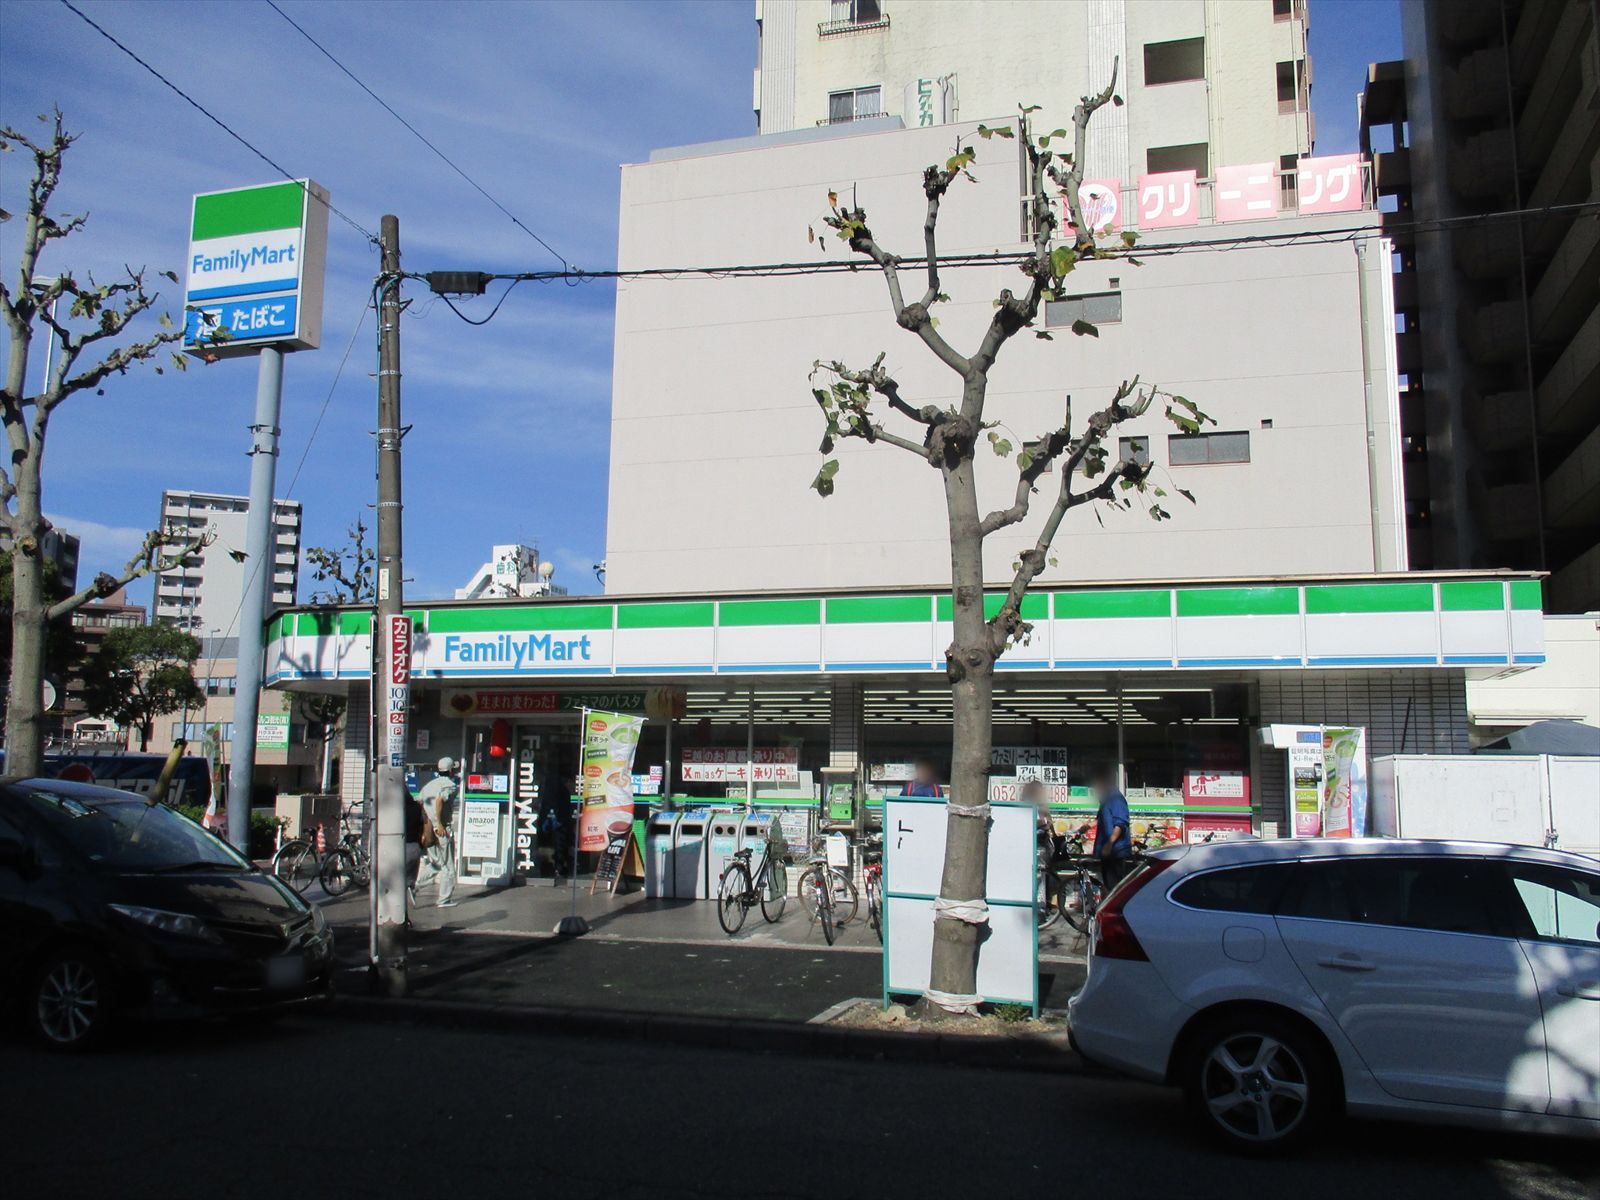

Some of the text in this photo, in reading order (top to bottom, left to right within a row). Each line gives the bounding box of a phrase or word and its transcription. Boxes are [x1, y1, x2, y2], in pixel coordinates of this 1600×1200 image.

[1141, 162, 1359, 219] クリーニング
[192, 244, 295, 273] FamilyMart
[232, 304, 286, 331] たばこ
[394, 619, 408, 683] カラオケ
[445, 634, 591, 669] FamilyMart
[563, 695, 641, 709] ファミマのパスタ
[1043, 767, 1067, 783] 募集中
[515, 735, 541, 871] FamilyMart
[468, 816, 495, 825] amazon
